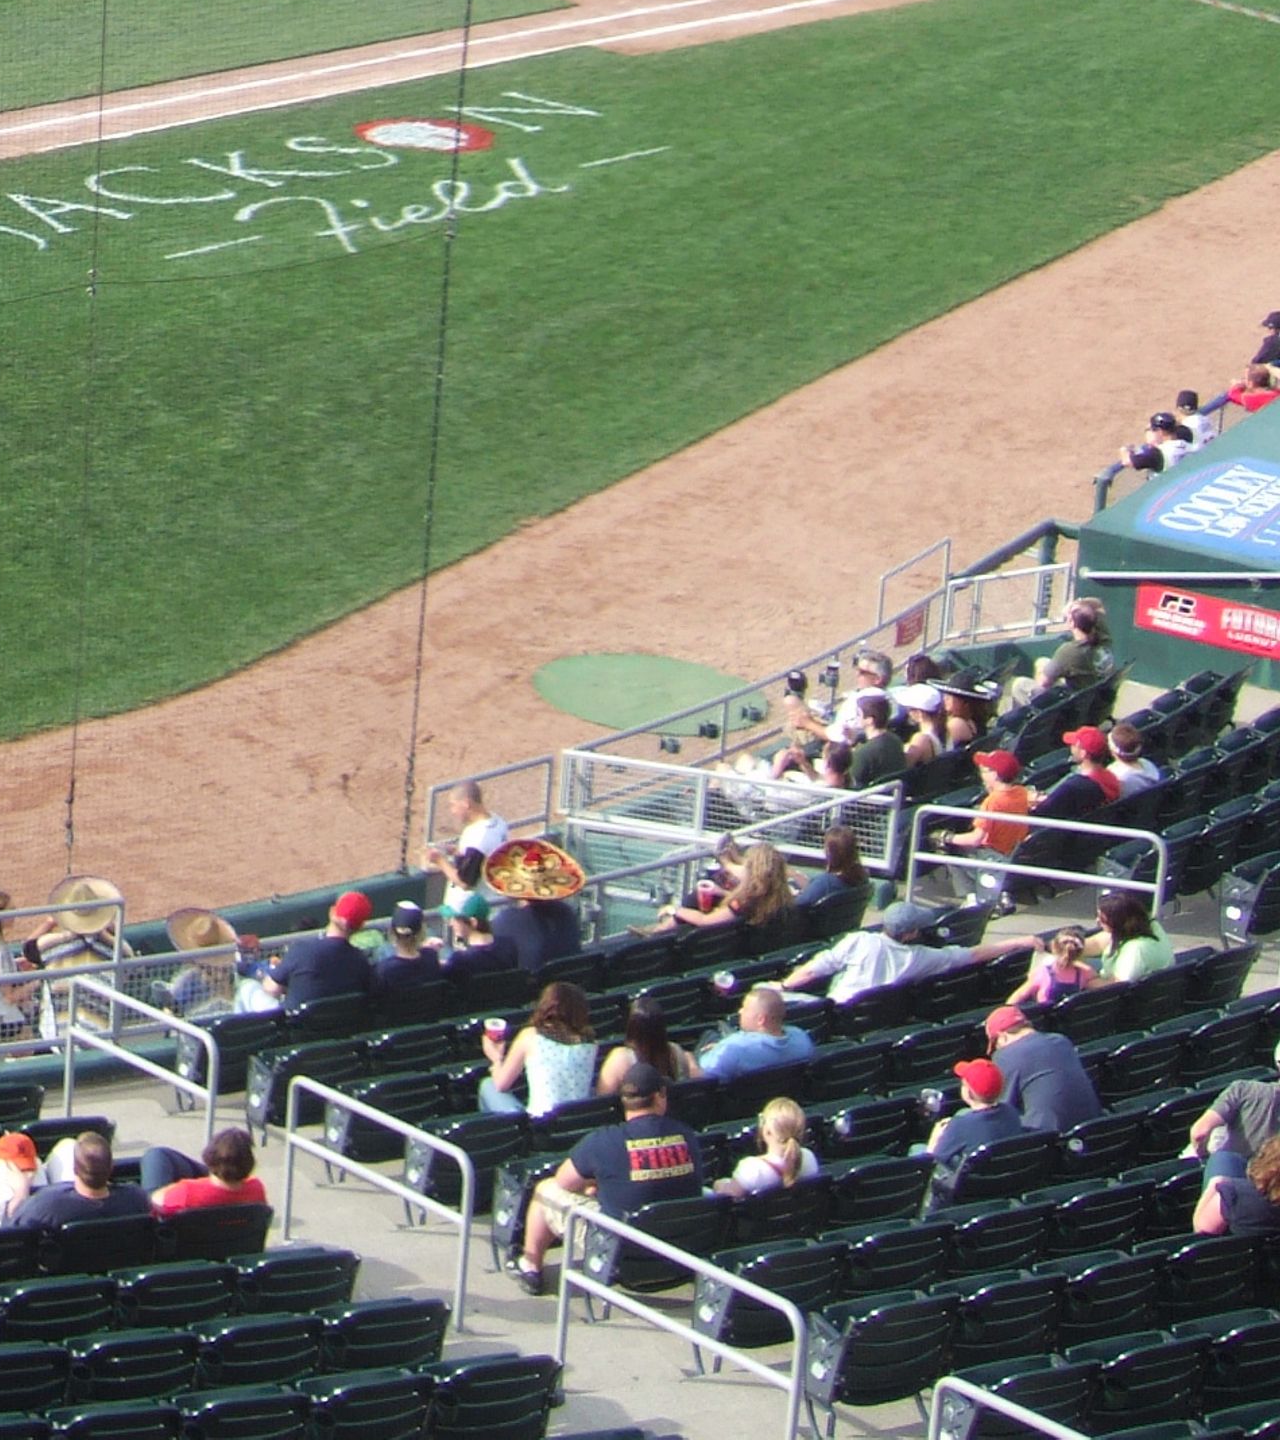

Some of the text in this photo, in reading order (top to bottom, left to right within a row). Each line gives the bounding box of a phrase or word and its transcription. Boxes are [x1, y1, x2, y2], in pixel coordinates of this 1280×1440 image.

[233, 157, 570, 253] Field
[1158, 464, 1278, 532] COOLEY
[630, 1145, 689, 1171] FIRE
